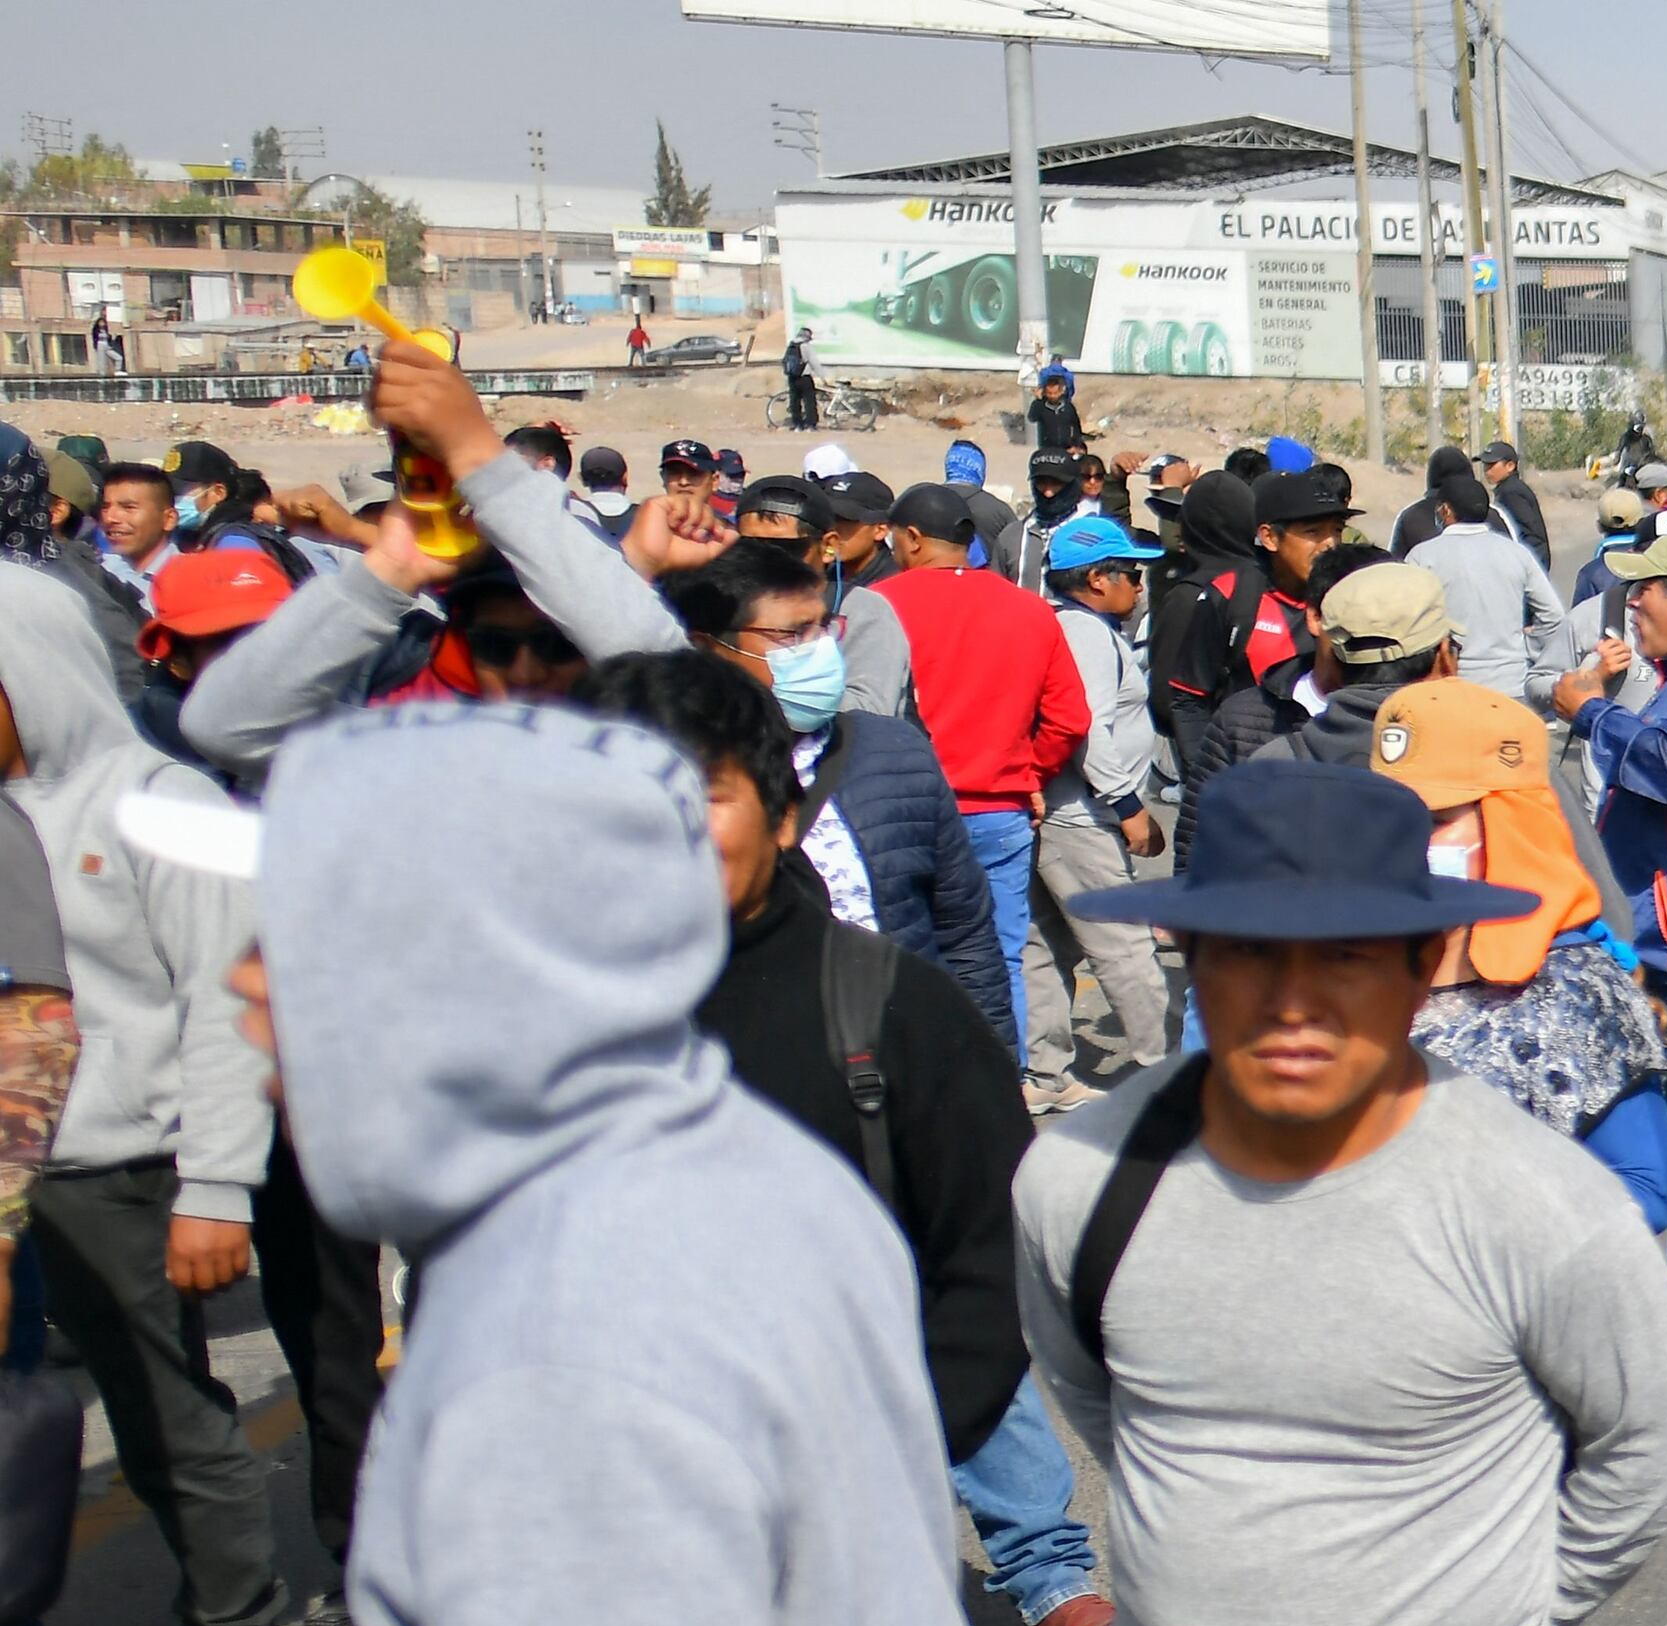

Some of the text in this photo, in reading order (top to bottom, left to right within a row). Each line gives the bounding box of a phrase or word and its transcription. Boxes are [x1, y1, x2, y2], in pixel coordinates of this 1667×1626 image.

[929, 201, 1057, 222] Hankok
[1221, 214, 1251, 237] EL
[1383, 218, 1415, 241] DE
[1138, 264, 1228, 281] Hankook
[1258, 261, 1326, 274] SERVICIO DE
[1257, 280, 1351, 293] MANTENIMIENTO
[1259, 298, 1328, 311] EN GENERAL
[1261, 319, 1313, 331] BATERIAS
[1262, 337, 1305, 350] ACEITES
